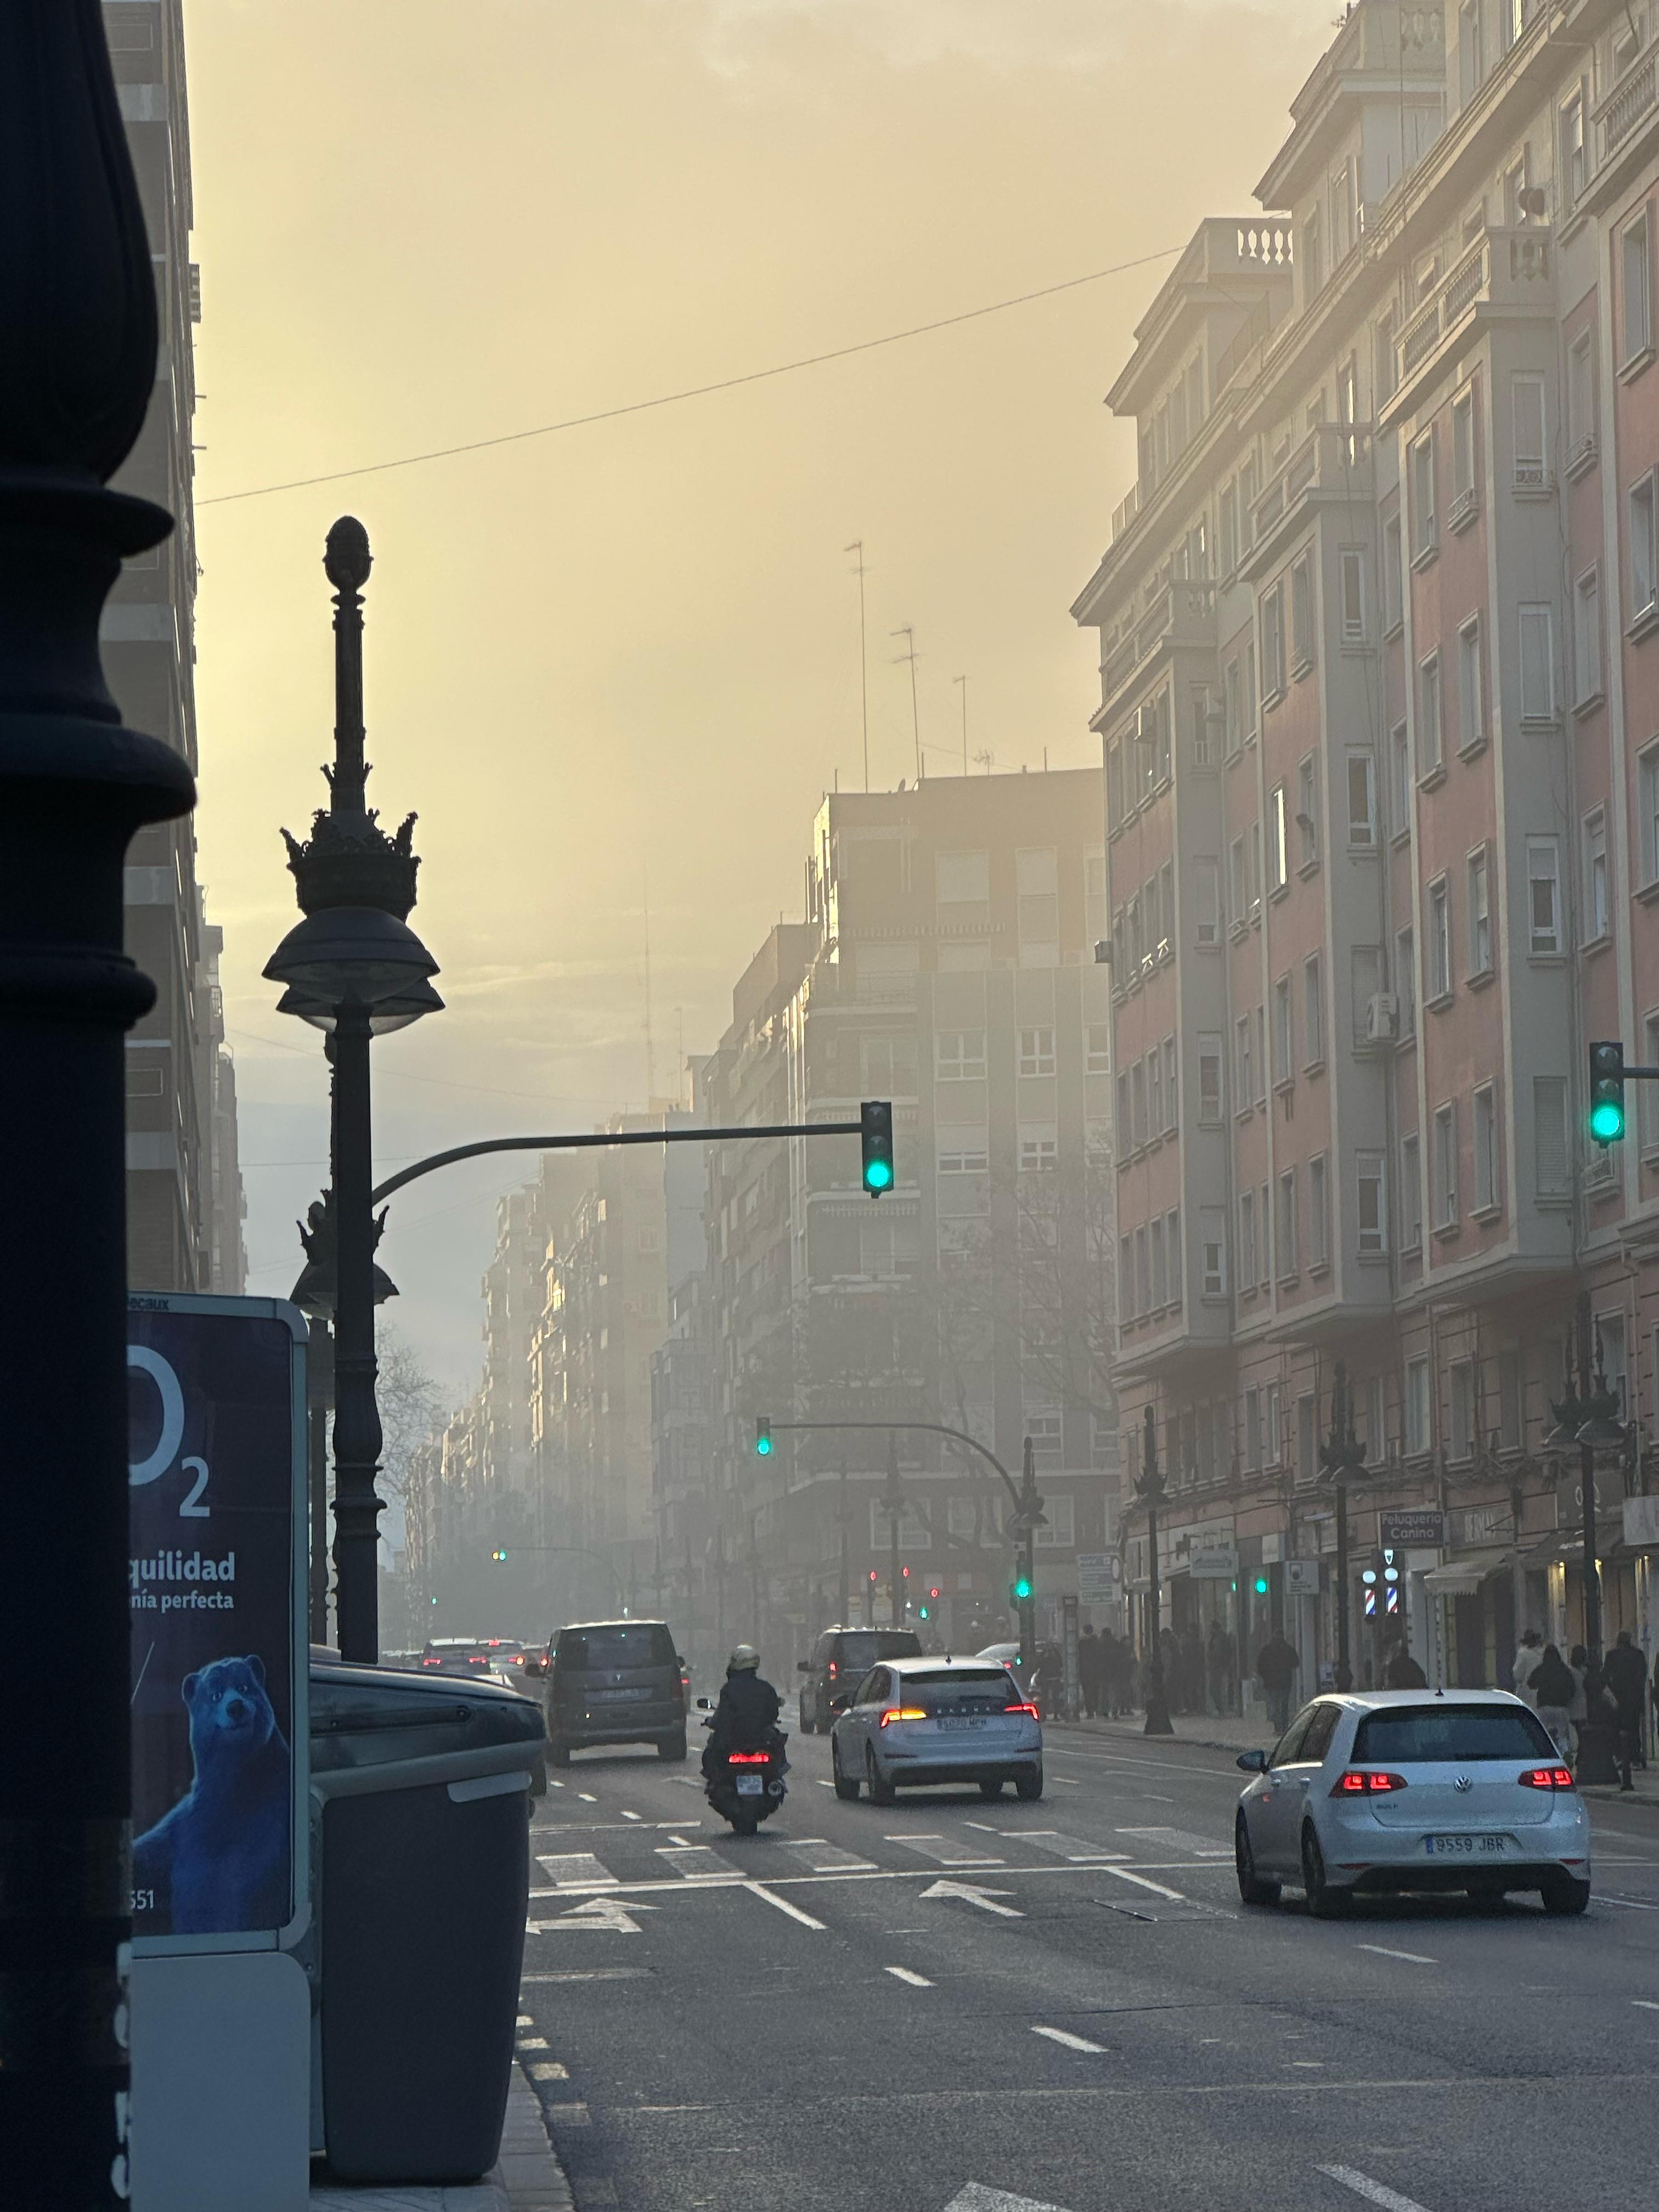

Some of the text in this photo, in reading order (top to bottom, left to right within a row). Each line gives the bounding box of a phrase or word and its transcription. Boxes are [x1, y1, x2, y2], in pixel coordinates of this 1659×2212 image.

[130, 1298, 169, 1310] ecaux
[129, 1550, 235, 1588] quilidad
[129, 1589, 234, 1613] nía perfecta
